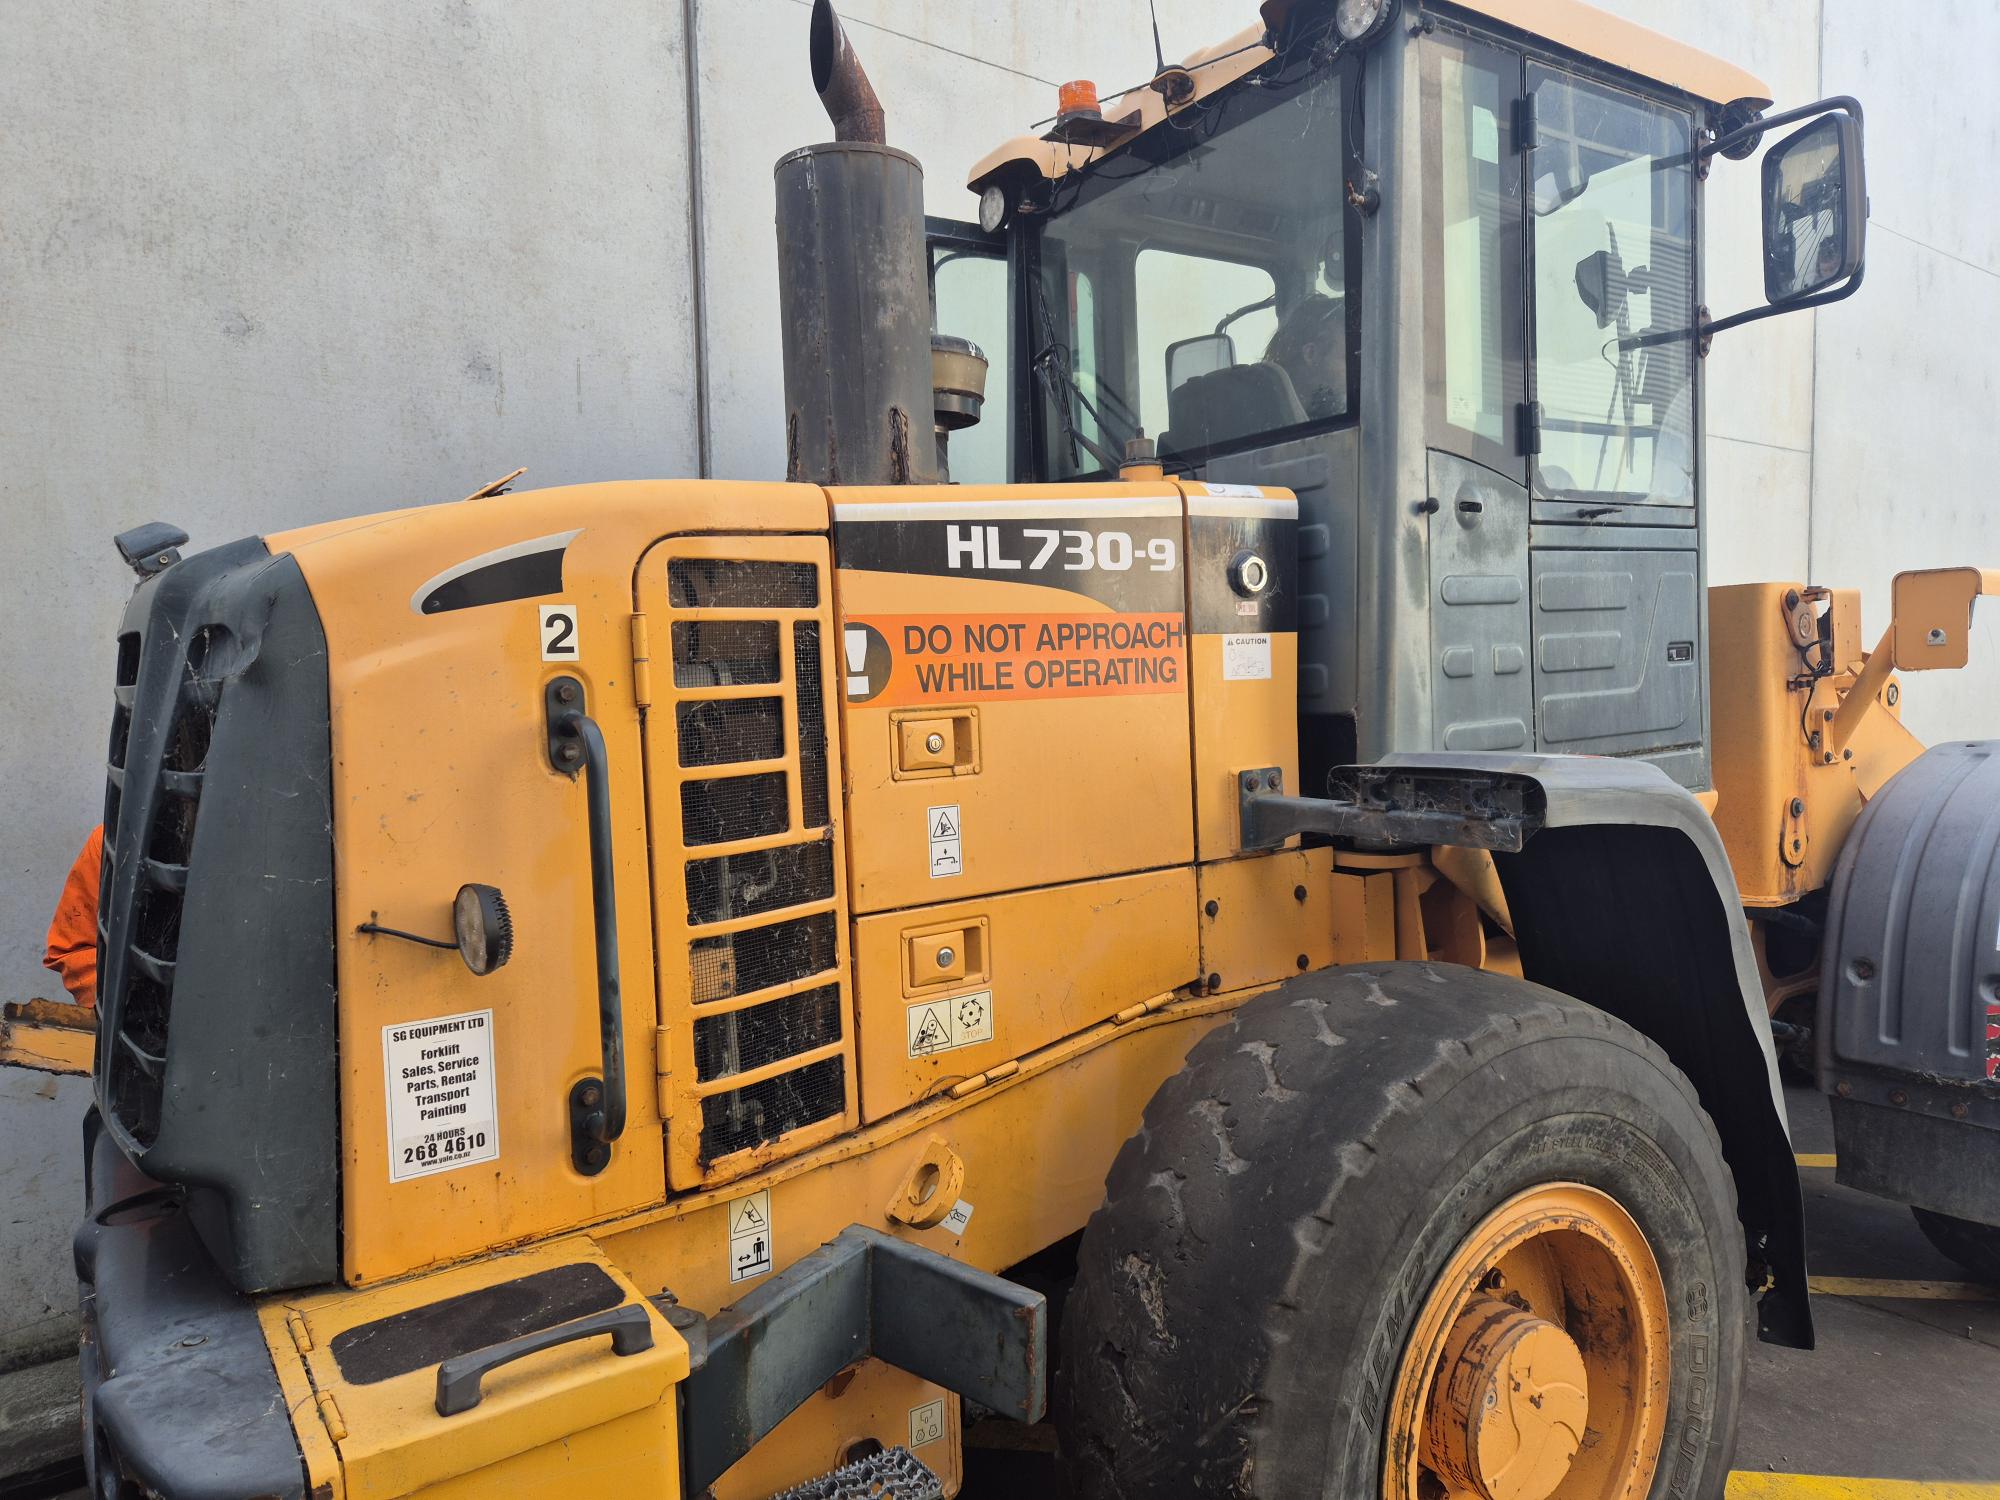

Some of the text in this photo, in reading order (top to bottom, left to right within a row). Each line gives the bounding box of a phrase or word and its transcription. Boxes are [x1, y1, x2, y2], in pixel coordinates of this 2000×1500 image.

[946, 525, 1176, 571] HL730-9
[545, 613, 575, 654] 2
[904, 621, 1183, 655] DO NOT APPROACH
[915, 656, 1177, 693] WHILE OPERATING
[392, 1017, 484, 1043] SG EQUIPMENT LTD
[960, 1029, 984, 1041] STOP
[421, 1044, 460, 1060] Forklift
[402, 1056, 480, 1079] Sales, Service
[407, 1070, 477, 1093] Parts, Rental
[415, 1087, 470, 1106] Transport
[420, 1103, 467, 1121] Painting
[424, 1127, 466, 1143] 24 HOURS
[404, 1132, 486, 1163] 268 4610
[421, 1151, 471, 1167] www.yale.co.nz
